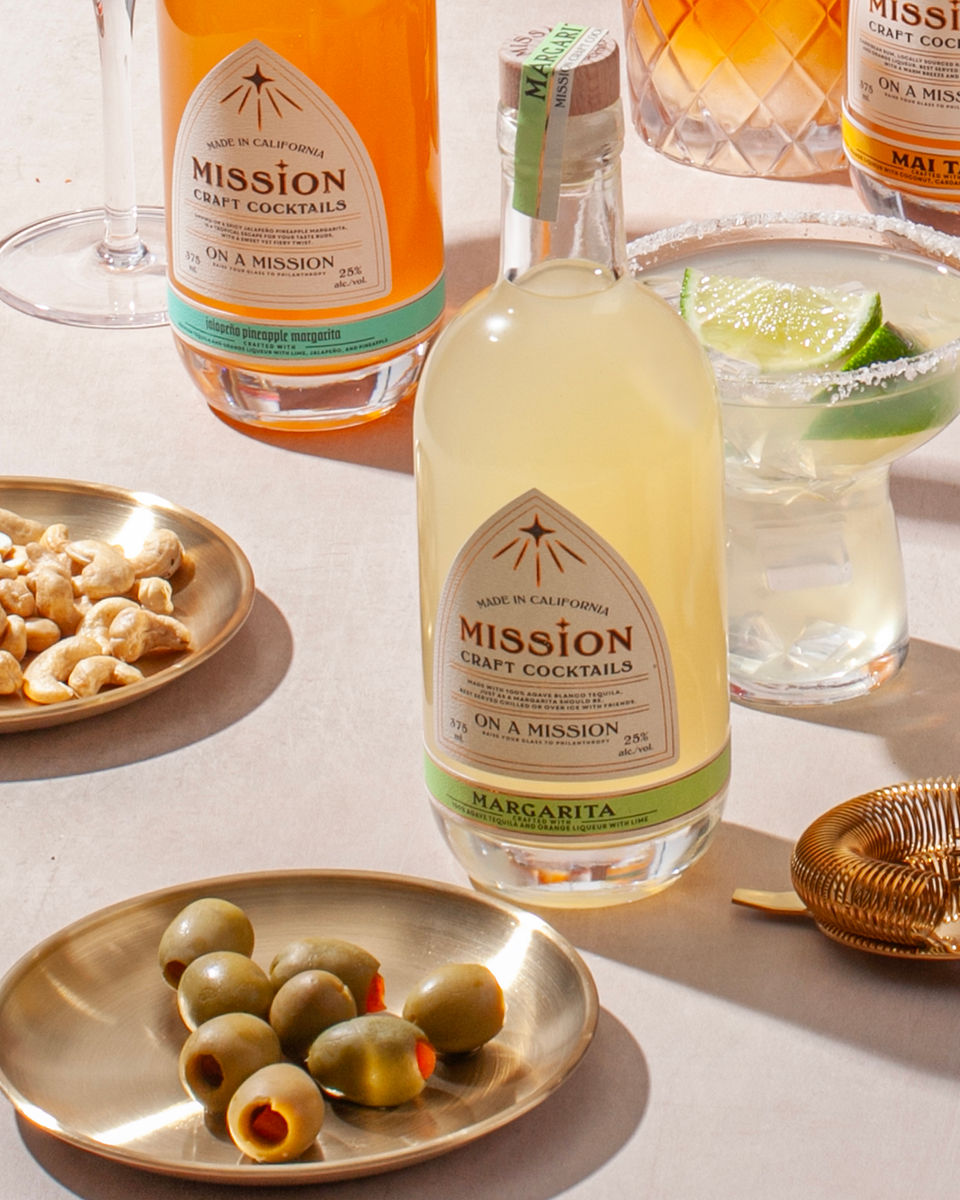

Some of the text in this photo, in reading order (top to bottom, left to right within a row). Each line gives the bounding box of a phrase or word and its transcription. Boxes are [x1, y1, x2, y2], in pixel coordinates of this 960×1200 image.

[868, 20, 913, 43] CRAFT
[525, 22, 583, 101] MARGARI
[879, 76, 900, 93] ON
[905, 85, 916, 98] A
[207, 138, 325, 159] MADE IN CALIFORNIA
[892, 151, 935, 172] MAI
[192, 156, 346, 195] MISSION
[193, 189, 347, 215] CRAFT COCKTAILS
[206, 246, 334, 270] ON A MISSION
[339, 265, 362, 278] 25%
[206, 317, 241, 337] jalapeño
[242, 326, 288, 343] pineapple
[290, 328, 341, 344] margarita
[476, 595, 609, 617] MADE IN CALIFORNIA
[459, 615, 633, 657] MISSION
[460, 650, 633, 678] CRAFT COCKTAILS
[475, 713, 619, 739] ON A MISSION
[623, 730, 649, 746] 25%
[472, 791, 616, 820] MARGARITA
[488, 816, 518, 827] TEQUILA
[572, 824, 607, 832] LIQUEUR
[609, 820, 629, 828] WITH
[631, 816, 648, 825] LIME
[512, 815, 547, 824] CRAFTED
